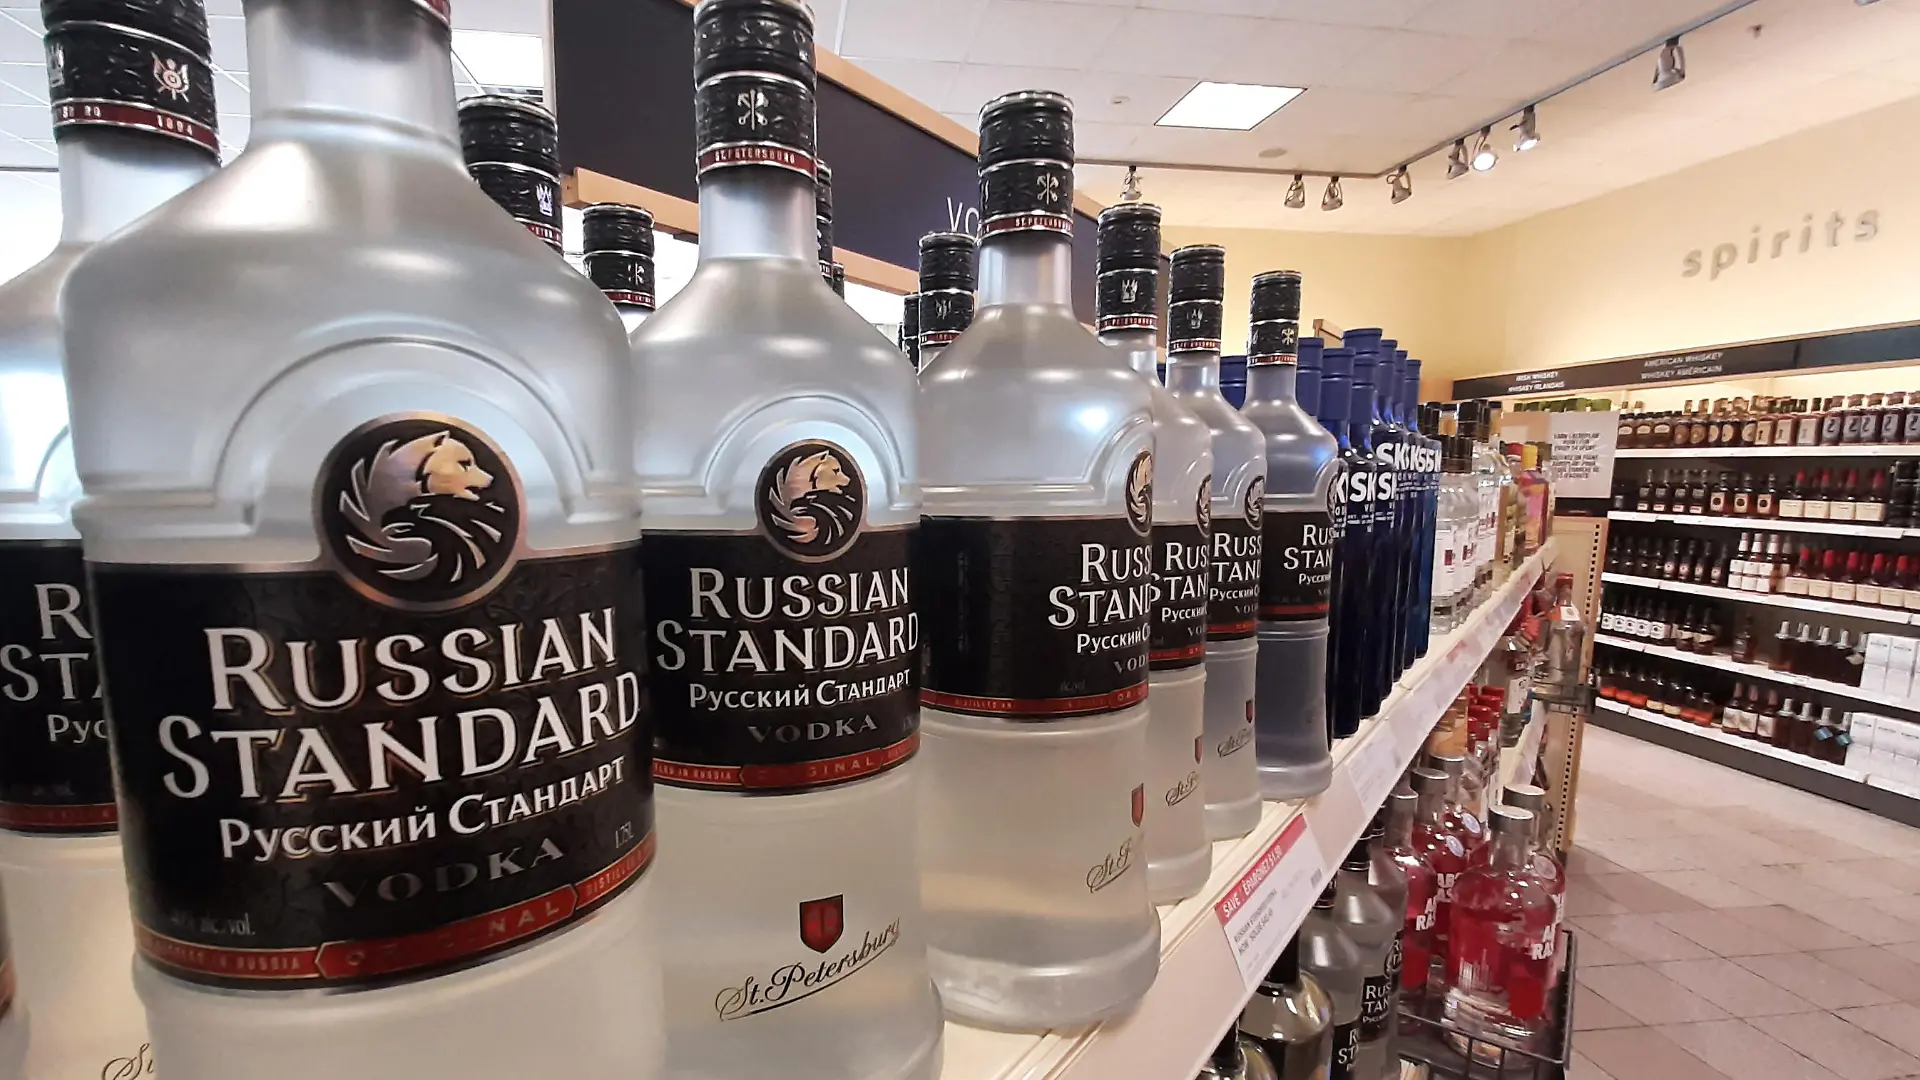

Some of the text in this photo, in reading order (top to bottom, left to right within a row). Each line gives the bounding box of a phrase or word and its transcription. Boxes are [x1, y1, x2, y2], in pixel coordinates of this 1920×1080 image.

[1681, 209, 1880, 282] spirits
[690, 566, 909, 620] RUSSIAN
[203, 607, 616, 713] RUSSIAN
[656, 612, 919, 673] STANDARD
[0, 644, 102, 702] ST
[689, 683, 810, 711] Русский
[158, 671, 641, 801] STANDARD
[748, 714, 878, 743] VODKA
[219, 805, 437, 864] Русский
[324, 838, 564, 908] VODKA
[1223, 892, 1241, 918] SAVE
